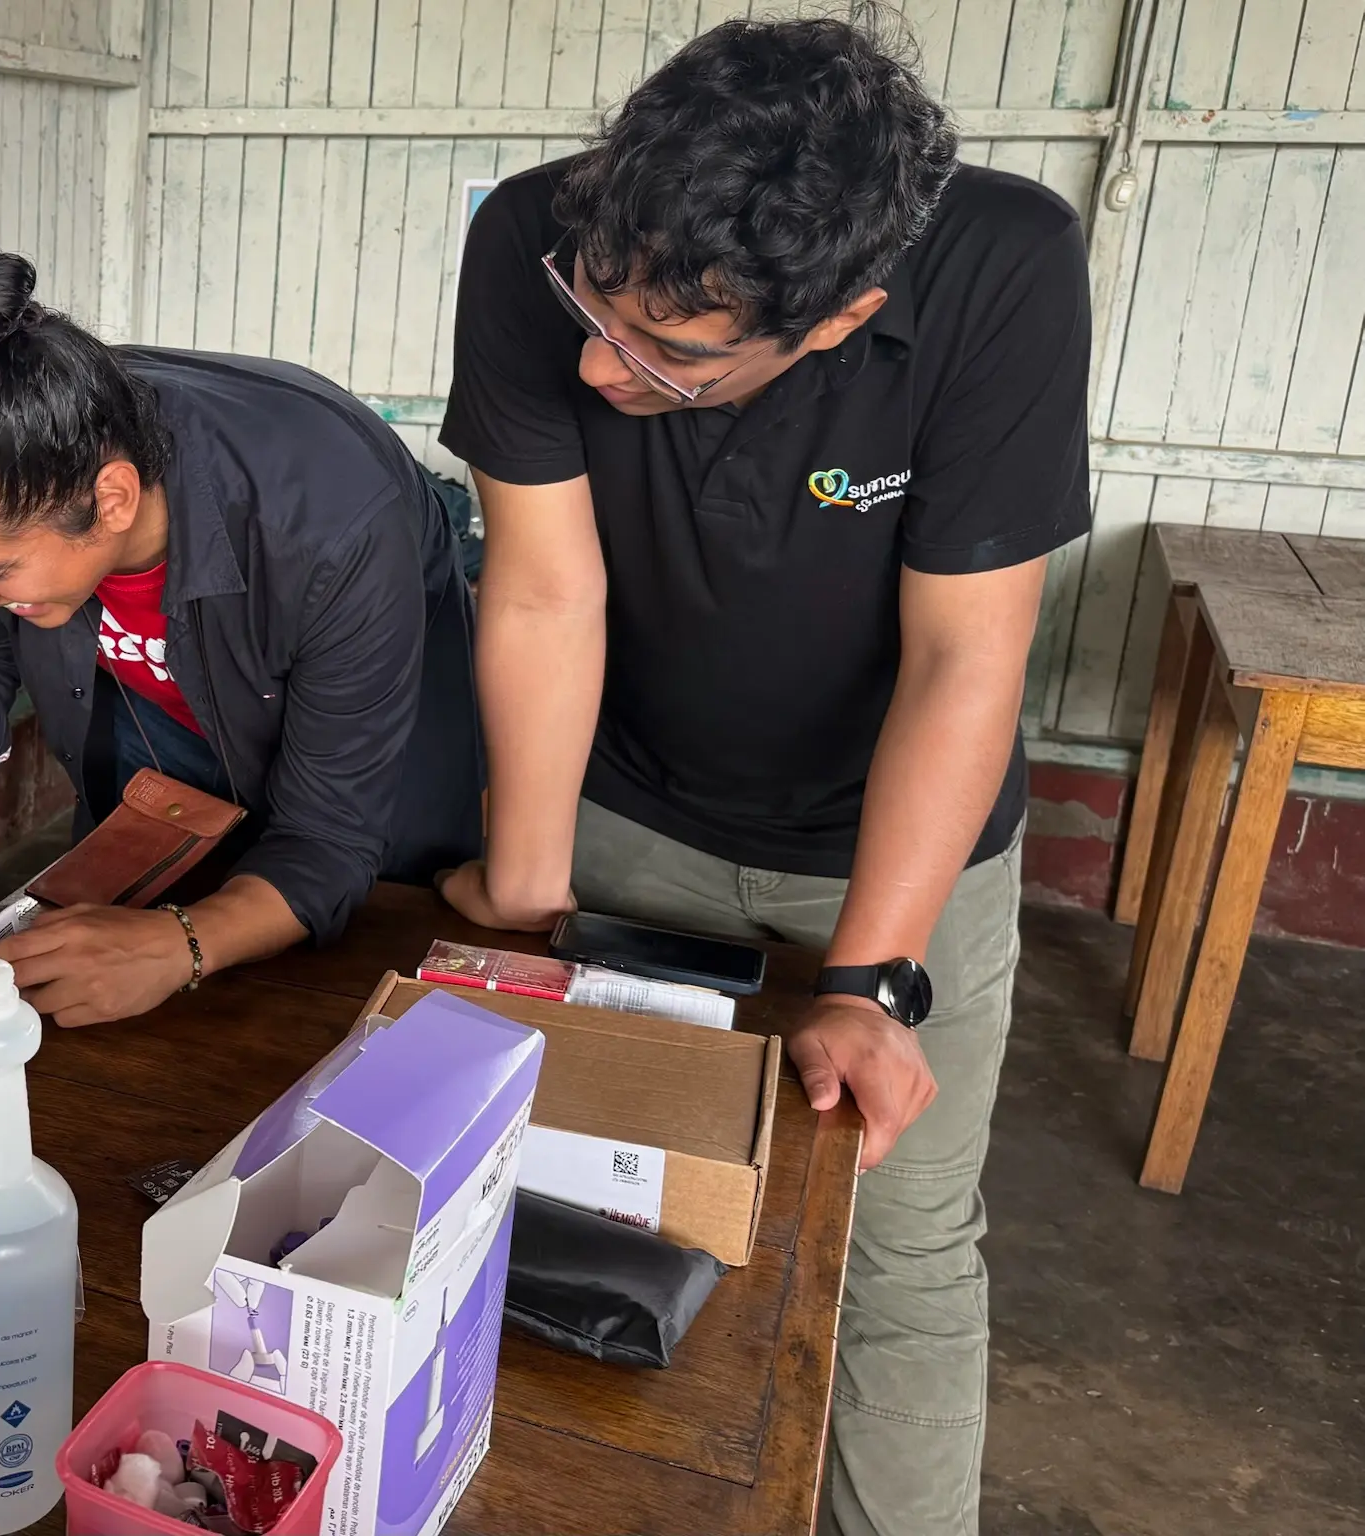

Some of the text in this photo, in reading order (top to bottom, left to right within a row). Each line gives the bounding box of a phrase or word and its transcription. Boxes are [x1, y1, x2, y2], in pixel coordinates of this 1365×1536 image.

[304, 1303, 313, 1319] 0.63
[324, 1301, 335, 1322] Gauge
[346, 1307, 355, 1319] 1.3
[365, 1313, 377, 1350] Penetration
[300, 1347, 309, 1359] (23
[342, 1350, 351, 1361] 1.8
[363, 1350, 373, 1370] depth
[322, 1358, 330, 1367] de
[339, 1392, 347, 1403] 2.3
[360, 1375, 371, 1409] Profondeur
[360, 1410, 368, 1419] de
[6, 1442, 25, 1453] BPM
[353, 1445, 365, 1481] Profundidad
[270, 1471, 284, 1503] Hb 201
[341, 1476, 352, 1509] Kedalaman
[353, 1482, 362, 1491] de
